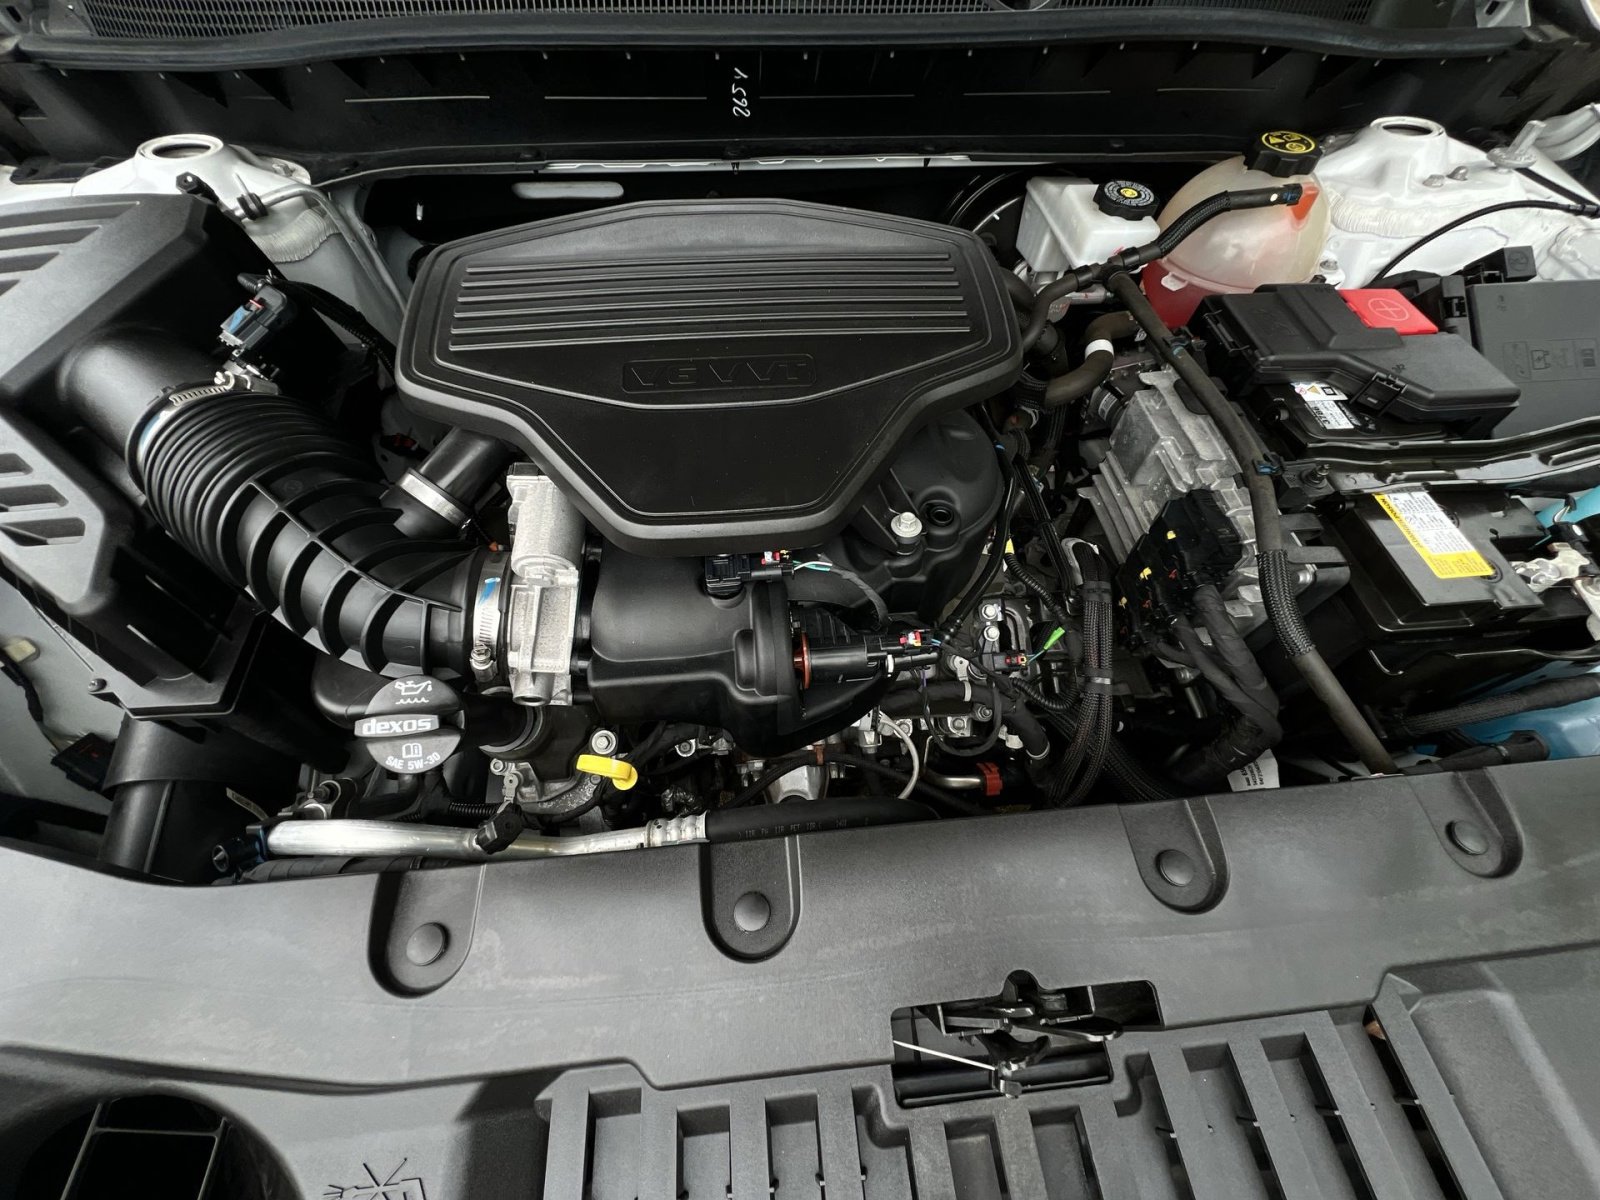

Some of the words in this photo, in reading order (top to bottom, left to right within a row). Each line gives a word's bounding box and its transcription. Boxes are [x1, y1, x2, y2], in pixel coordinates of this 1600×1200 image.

[362, 718, 432, 735] dexos
[385, 755, 405, 770] SAE
[407, 751, 441, 770] 5W-30
